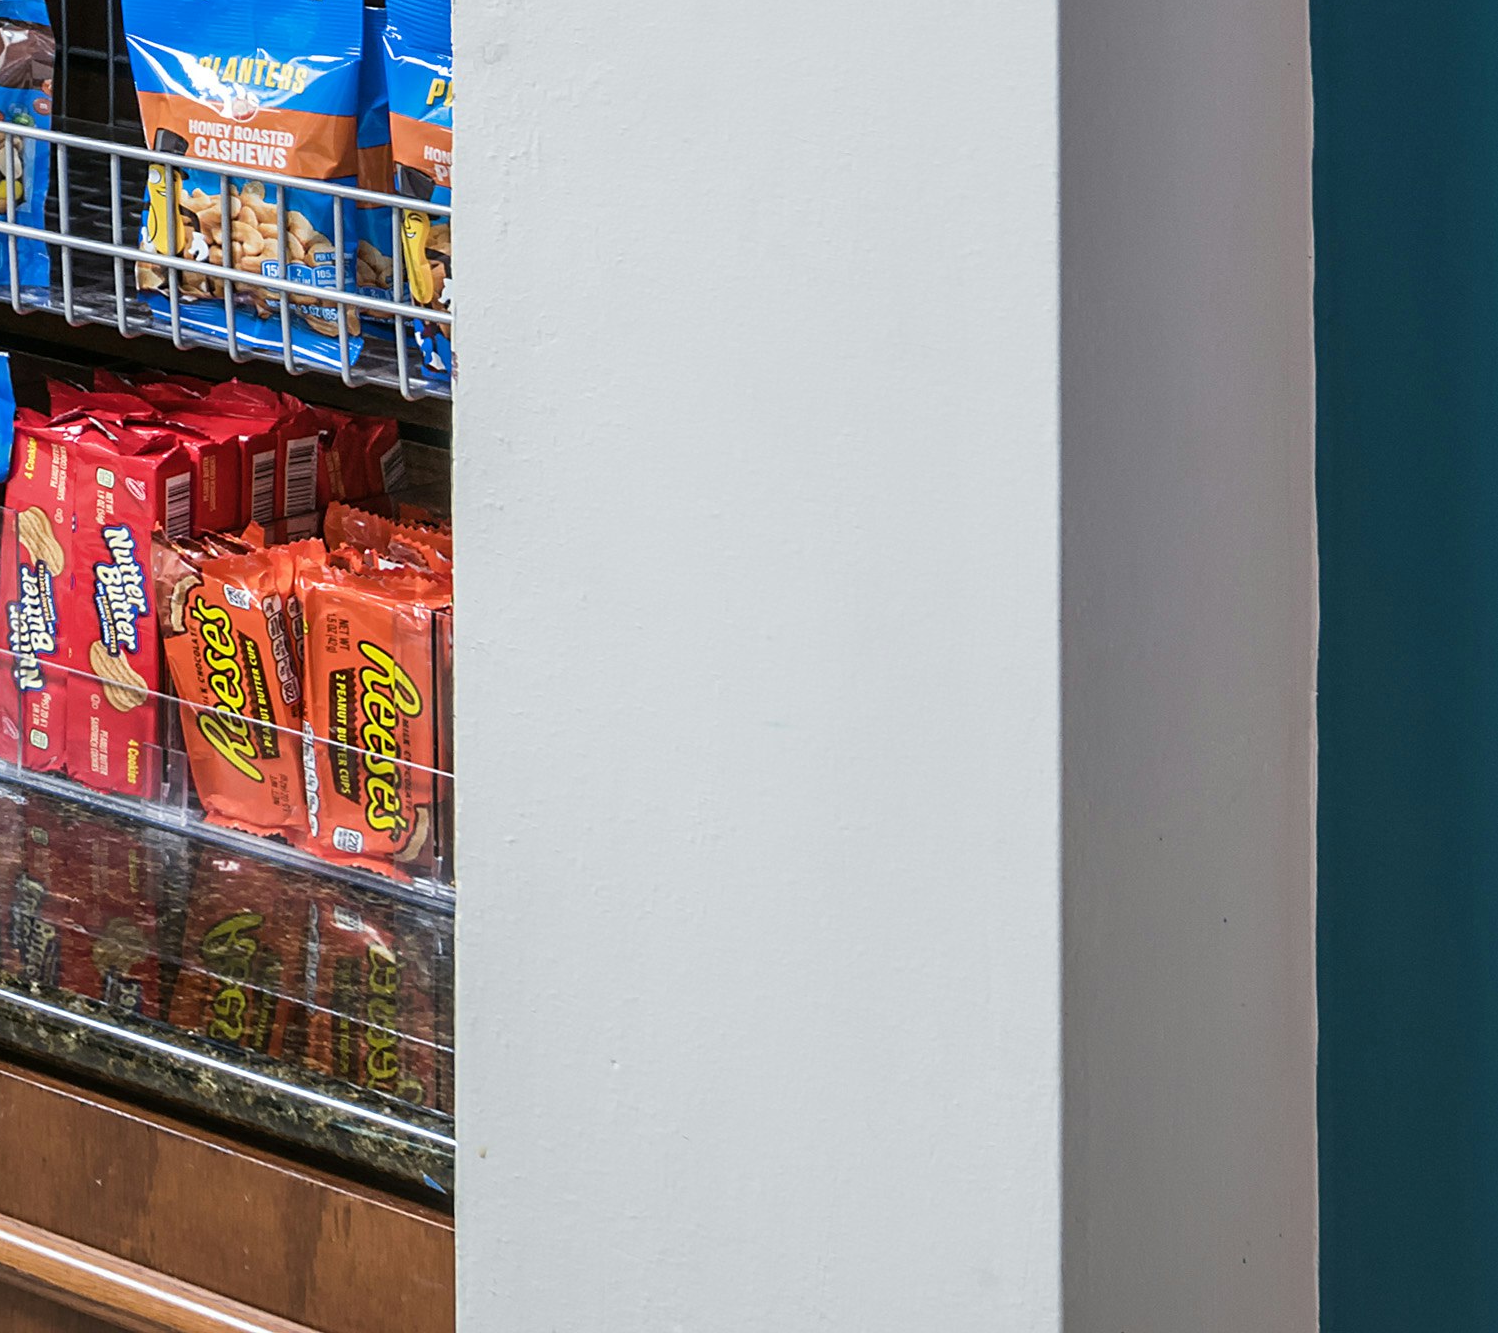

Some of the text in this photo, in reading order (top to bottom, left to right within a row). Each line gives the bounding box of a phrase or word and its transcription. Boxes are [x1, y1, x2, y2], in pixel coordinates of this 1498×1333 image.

[188, 119, 295, 148] HONEY ROASTED
[193, 137, 288, 170] CASHEWS
[103, 525, 148, 616] Nutter
[20, 564, 55, 655] Butter
[95, 563, 138, 653] Butter
[197, 597, 263, 782] Reese's
[338, 682, 348, 725] PEANUT
[338, 727, 349, 769] BUTTER
[359, 640, 423, 833] Reese's
[127, 749, 139, 784] Cookies
[341, 770, 351, 795] CUPS
[349, 830, 360, 851] 220
